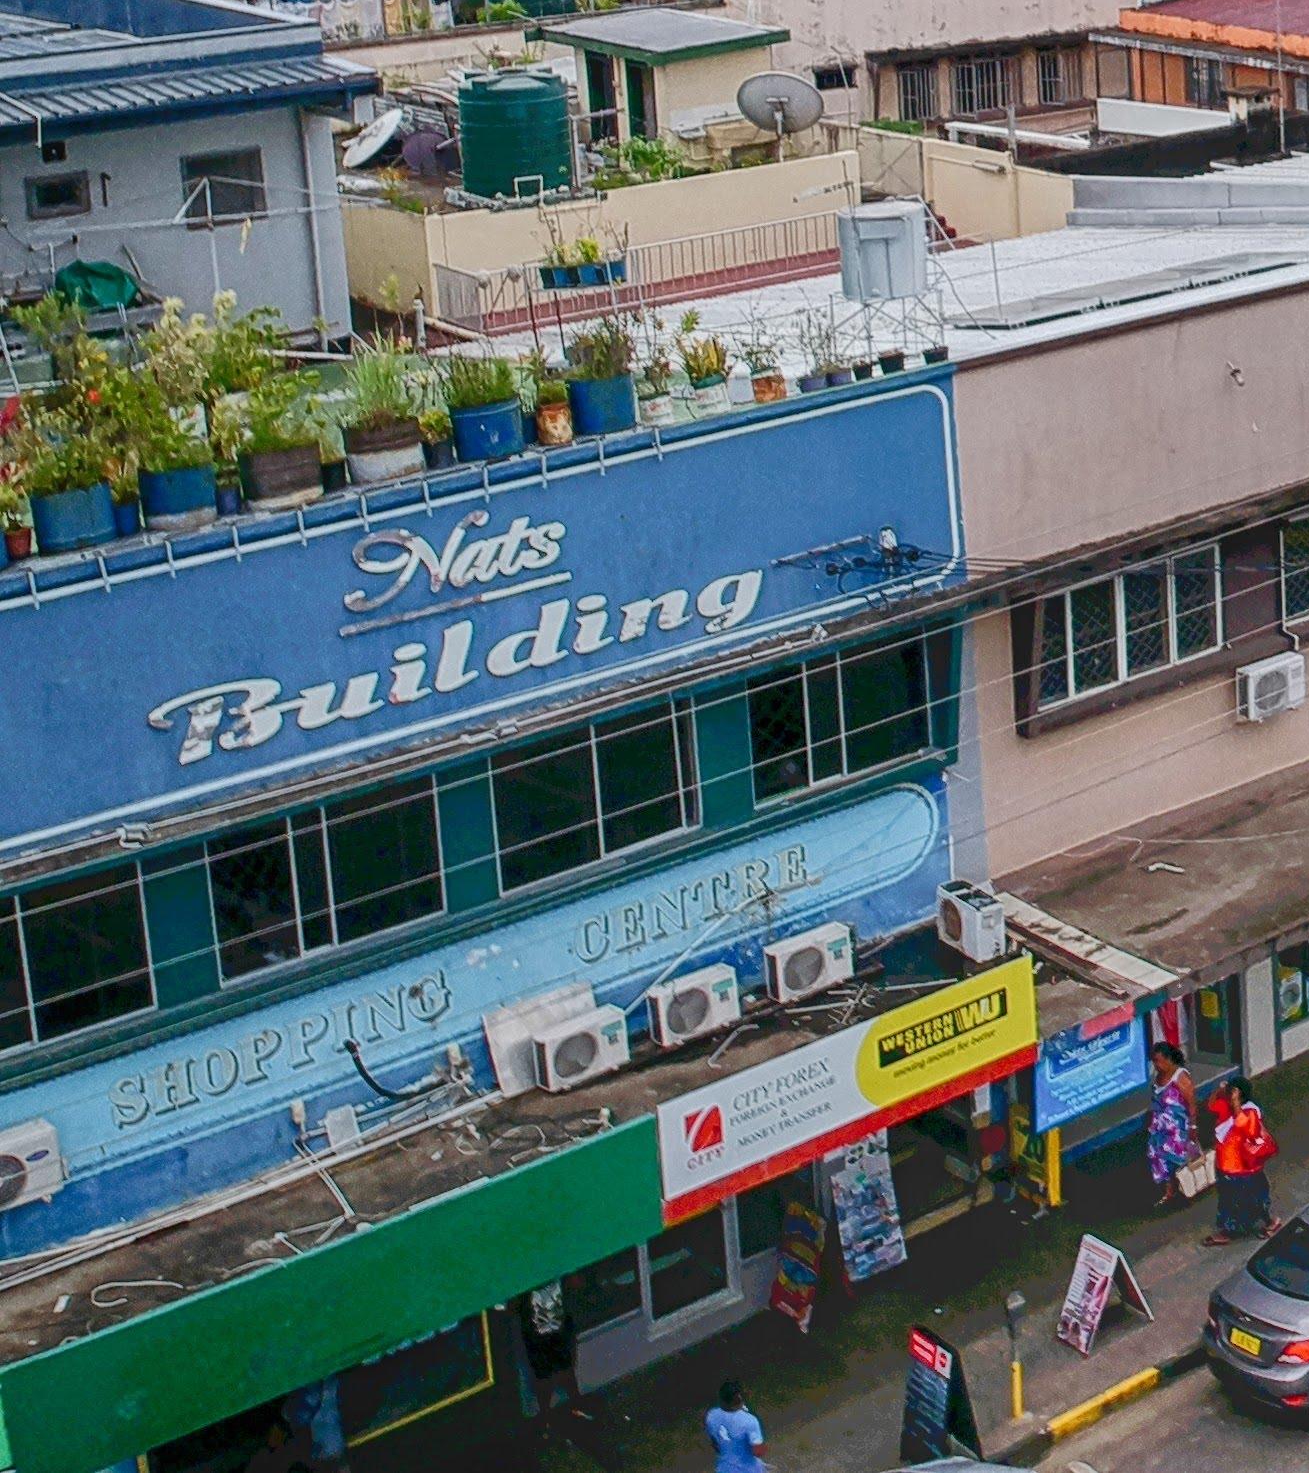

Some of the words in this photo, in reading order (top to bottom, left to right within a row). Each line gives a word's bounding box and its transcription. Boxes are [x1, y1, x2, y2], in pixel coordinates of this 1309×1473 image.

[342, 510, 568, 615] Nats
[148, 568, 764, 766] Building
[575, 843, 812, 964] CENTRE
[960, 993, 1000, 1030] WU
[106, 968, 455, 1129] SHOPPING
[881, 1012, 953, 1052] WESTERN
[904, 1026, 954, 1055] UNION
[733, 1081, 771, 1112] CITY
[775, 1057, 830, 1093] FOREX
[729, 1101, 777, 1127] FOREIGN
[778, 1102, 833, 1131] TRANSFER
[687, 1145, 725, 1170] CITY
